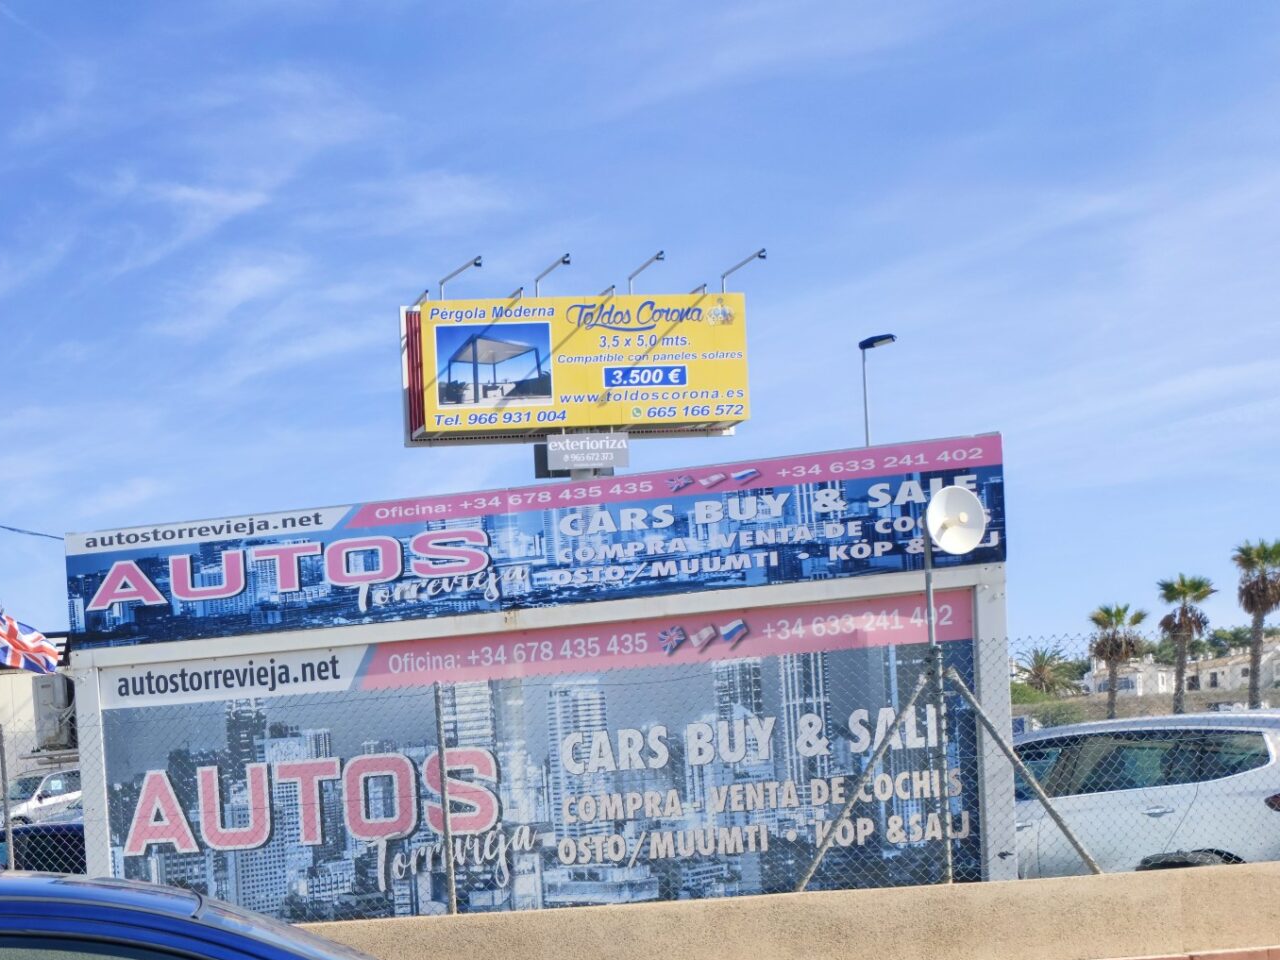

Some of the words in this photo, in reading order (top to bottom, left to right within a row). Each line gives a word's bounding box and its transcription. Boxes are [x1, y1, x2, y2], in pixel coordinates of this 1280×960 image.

[430, 307, 486, 322] Pérgola
[491, 305, 555, 319] Moderna
[566, 303, 632, 330] Toldos
[637, 300, 703, 325] Corona
[558, 353, 624, 365] Compatible
[628, 353, 649, 362] con
[653, 351, 698, 363] paneles
[701, 350, 743, 360] solares
[599, 335, 619, 349] 3,5
[624, 338, 631, 347] x
[637, 335, 658, 348] 5,0
[661, 335, 691, 347] mts.
[611, 368, 663, 385] 3.500
[668, 368, 681, 383] €
[560, 390, 744, 403] www.toldoscorona.es
[647, 406, 677, 418] 665
[682, 405, 710, 417] 166
[715, 404, 744, 416] 572
[434, 414, 462, 426] Tel.
[468, 412, 498, 425] 966
[502, 411, 531, 423] 931
[537, 409, 567, 422] 004
[548, 436, 627, 451] exterioriza
[776, 463, 822, 478] +34
[829, 458, 876, 474] 633
[883, 453, 929, 469] 241
[936, 447, 983, 463] 402
[375, 504, 452, 520] Oficina:
[459, 497, 502, 511] +34
[508, 490, 552, 506] 678
[559, 485, 602, 500] 435
[609, 480, 653, 495] 435
[560, 505, 675, 537] CARS
[694, 493, 791, 524] BUY
[812, 488, 848, 513] &
[85, 511, 323, 549] autostorrevieja.net
[559, 537, 689, 562] COMPRA
[719, 526, 814, 548] VENTA
[825, 520, 862, 539] DE
[829, 538, 893, 561] KÖP
[86, 528, 493, 612] AUTOS
[348, 566, 530, 612] Torrevieja
[762, 617, 806, 640] +34
[812, 613, 856, 637] 633
[863, 608, 904, 632] 241
[389, 652, 460, 674] Oficina:
[467, 645, 507, 667] +34
[513, 641, 554, 663] 678
[559, 636, 601, 660] 435
[606, 632, 648, 655] 435
[118, 655, 340, 697] autostorrevieja.net
[561, 724, 670, 775] CARS
[686, 714, 777, 766] BUY
[797, 712, 832, 758] &
[124, 746, 502, 856] AUTOS
[563, 789, 683, 823] COMPRA
[710, 780, 801, 813] VENTA
[810, 777, 846, 806] DE
